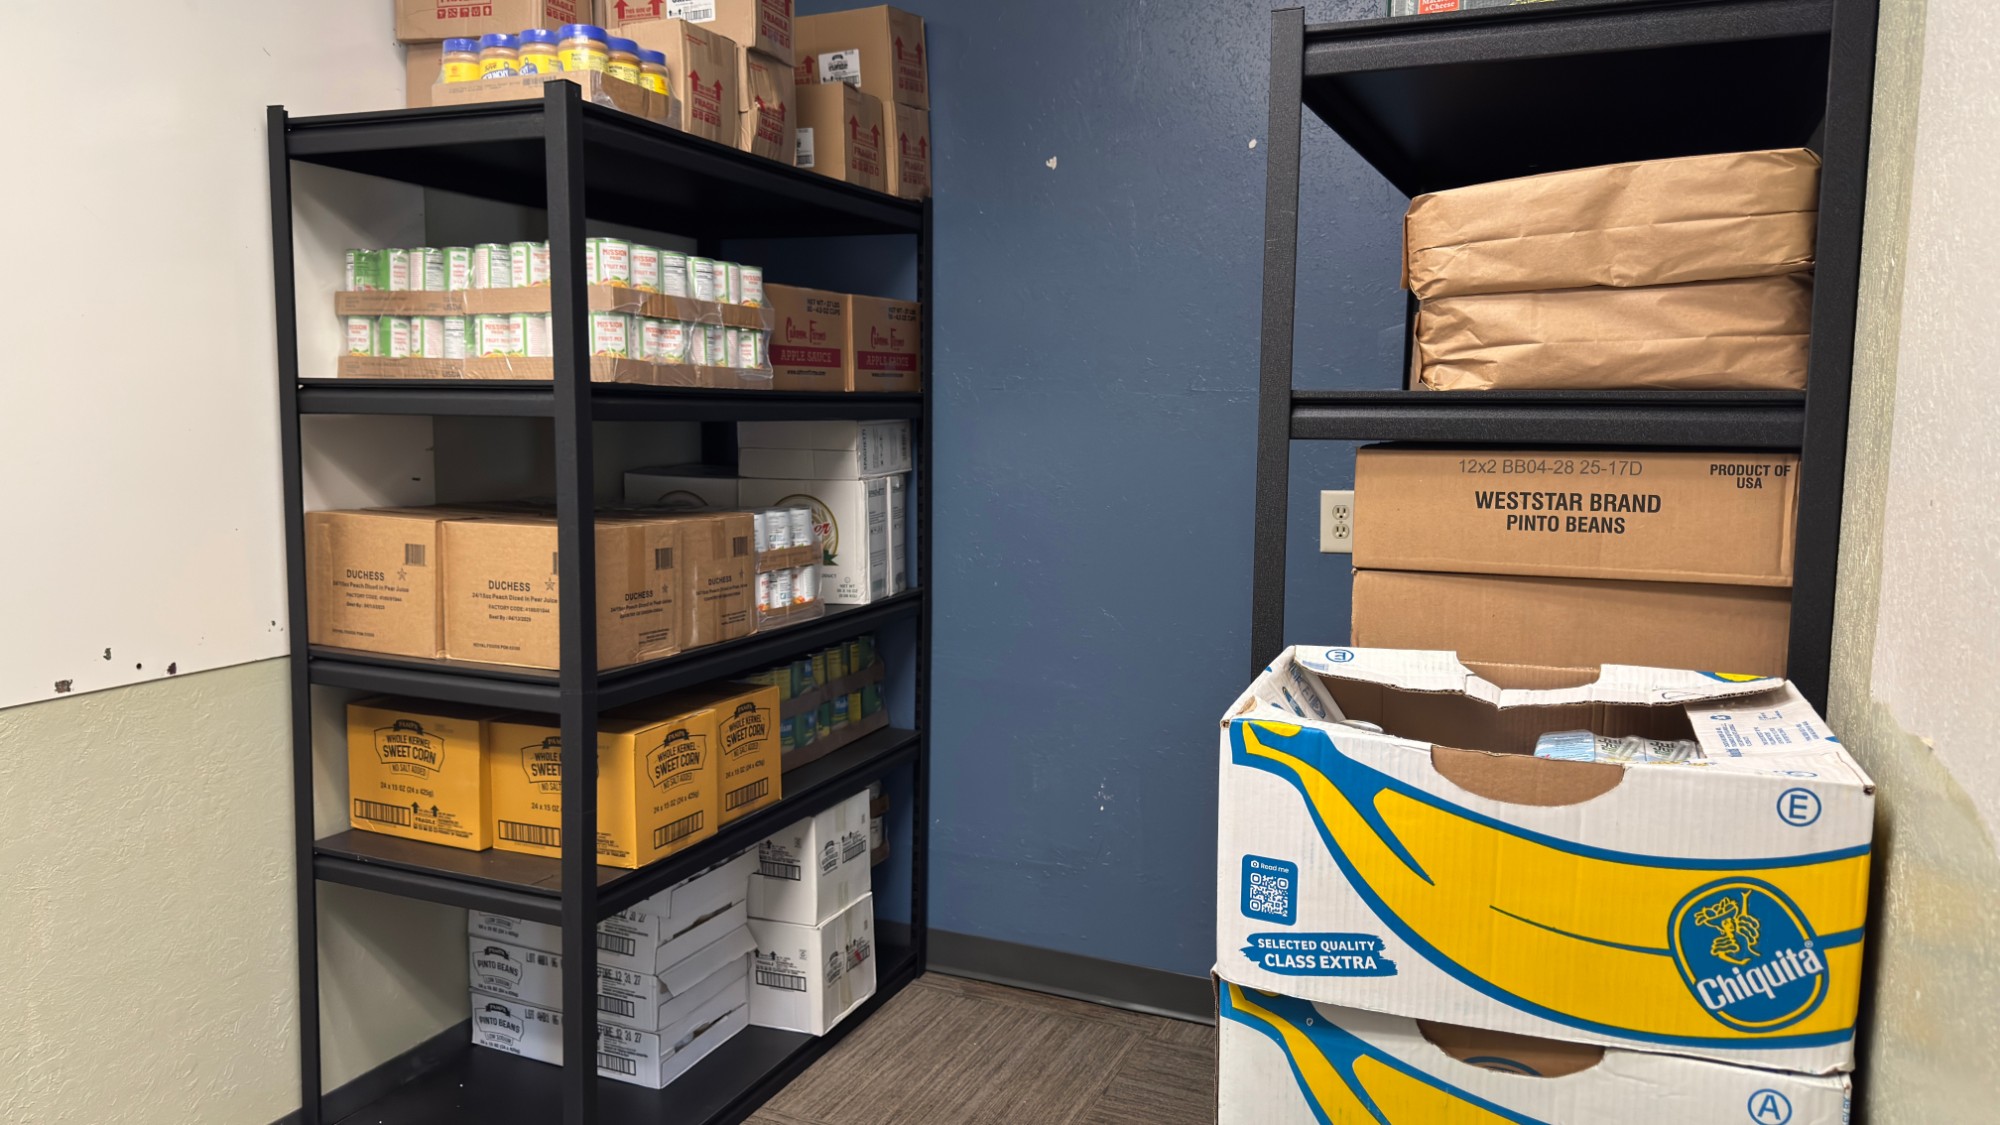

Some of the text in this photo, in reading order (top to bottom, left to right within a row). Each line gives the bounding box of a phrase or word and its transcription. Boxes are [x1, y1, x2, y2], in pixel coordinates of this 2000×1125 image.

[1429, 1, 1456, 10] Cheese
[763, 11, 789, 30] FRAGILE
[695, 97, 719, 113] FRAGILE
[761, 118, 783, 134] FRAGILE
[854, 146, 878, 161] FRAGILE
[781, 350, 832, 363] APPLE SAUCE
[867, 355, 888, 366] APPLE
[1459, 460, 1643, 476] 12x2 BB04-28 25-17D
[1710, 464, 1791, 477] PRODUCT OF
[1737, 477, 1763, 489] USA
[1475, 491, 1661, 513] WESTSTAR BRAND
[1507, 515, 1626, 534] PINTO BEANS
[346, 569, 385, 581] DUCHESS
[708, 575, 732, 585] DUCHESS
[488, 580, 531, 592] DUCHESS
[625, 590, 653, 601] DUCHESS
[729, 715, 762, 733] WHOLE KERNEL
[386, 735, 431, 749] WHOLE KERNEL
[727, 724, 765, 747] SWEET CORN
[383, 745, 437, 765] SWEET CORN
[535, 753, 558, 761] WHOLE
[658, 742, 696, 762] WHOLE KERNEL
[392, 764, 427, 777] NO SALT ADDED
[655, 752, 700, 779] SWEET CORN
[1790, 795, 1808, 820] E
[1261, 863, 1290, 874] Read me
[1257, 939, 1376, 953] SELECTED QUALITY
[477, 959, 519, 976] PINTO BEANS
[1264, 953, 1378, 970] CLASS EXTRA
[1697, 947, 1823, 1011] Chiquita
[479, 1016, 521, 1033] PINTO BEANS
[634, 1032, 642, 1044] 27
[1757, 1094, 1781, 1120] A
